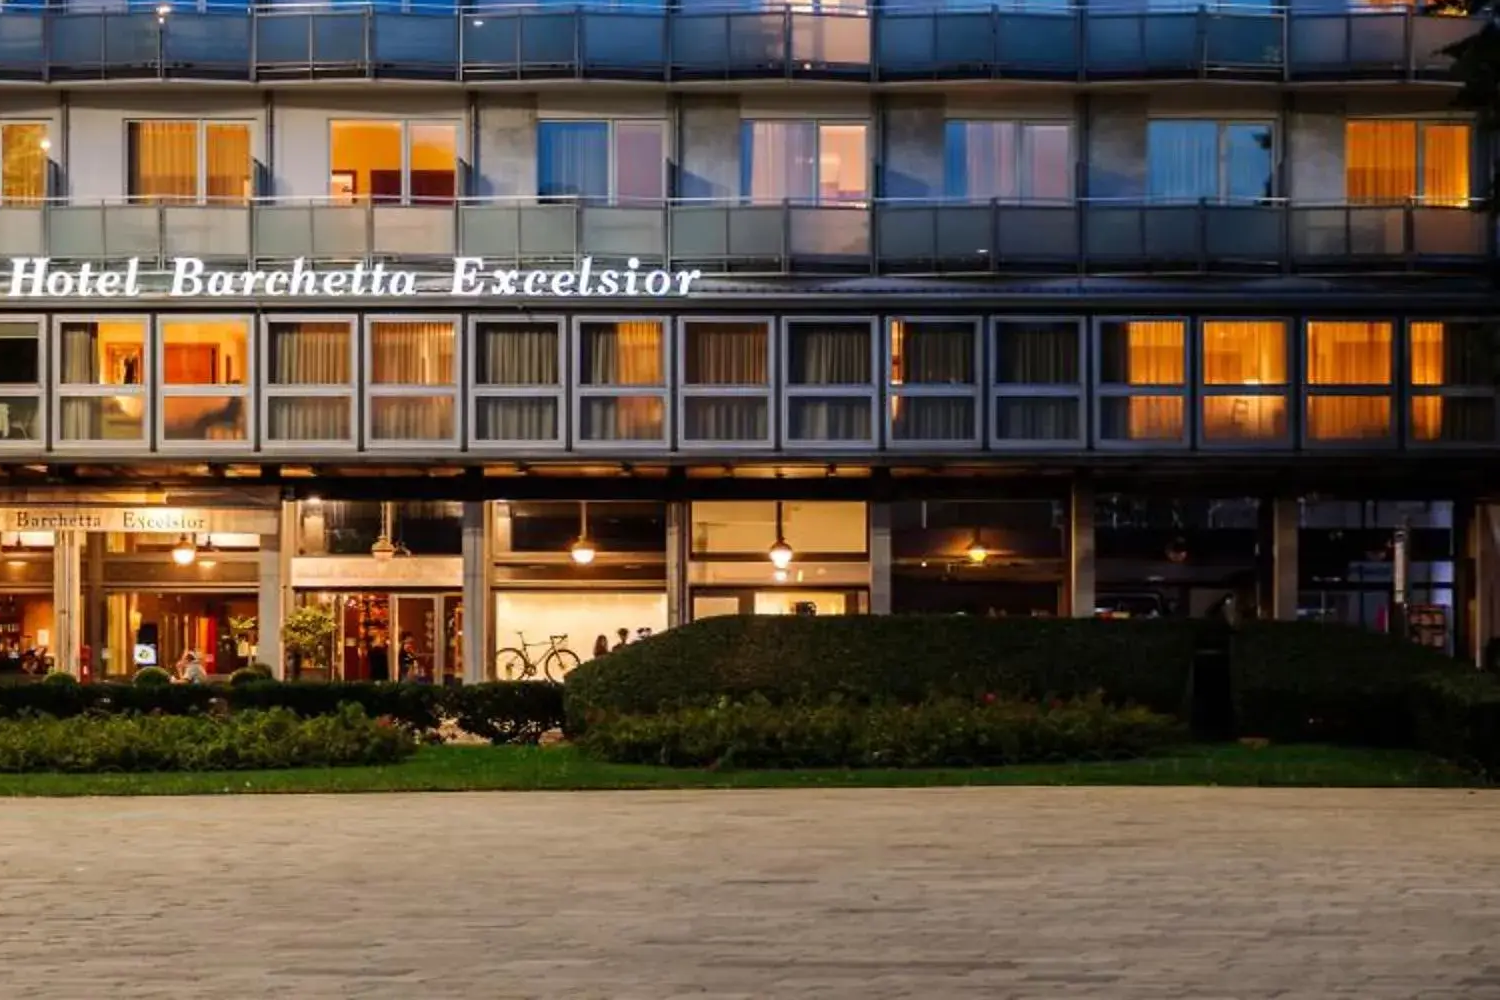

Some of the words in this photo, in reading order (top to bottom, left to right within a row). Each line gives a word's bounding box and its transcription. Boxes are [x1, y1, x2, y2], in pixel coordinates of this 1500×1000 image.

[8, 257, 141, 297] Hotel
[169, 257, 417, 297] Barchetta
[450, 256, 701, 296] Excelsior
[16, 511, 100, 528] Barchetta
[122, 511, 206, 529] Excelsior
